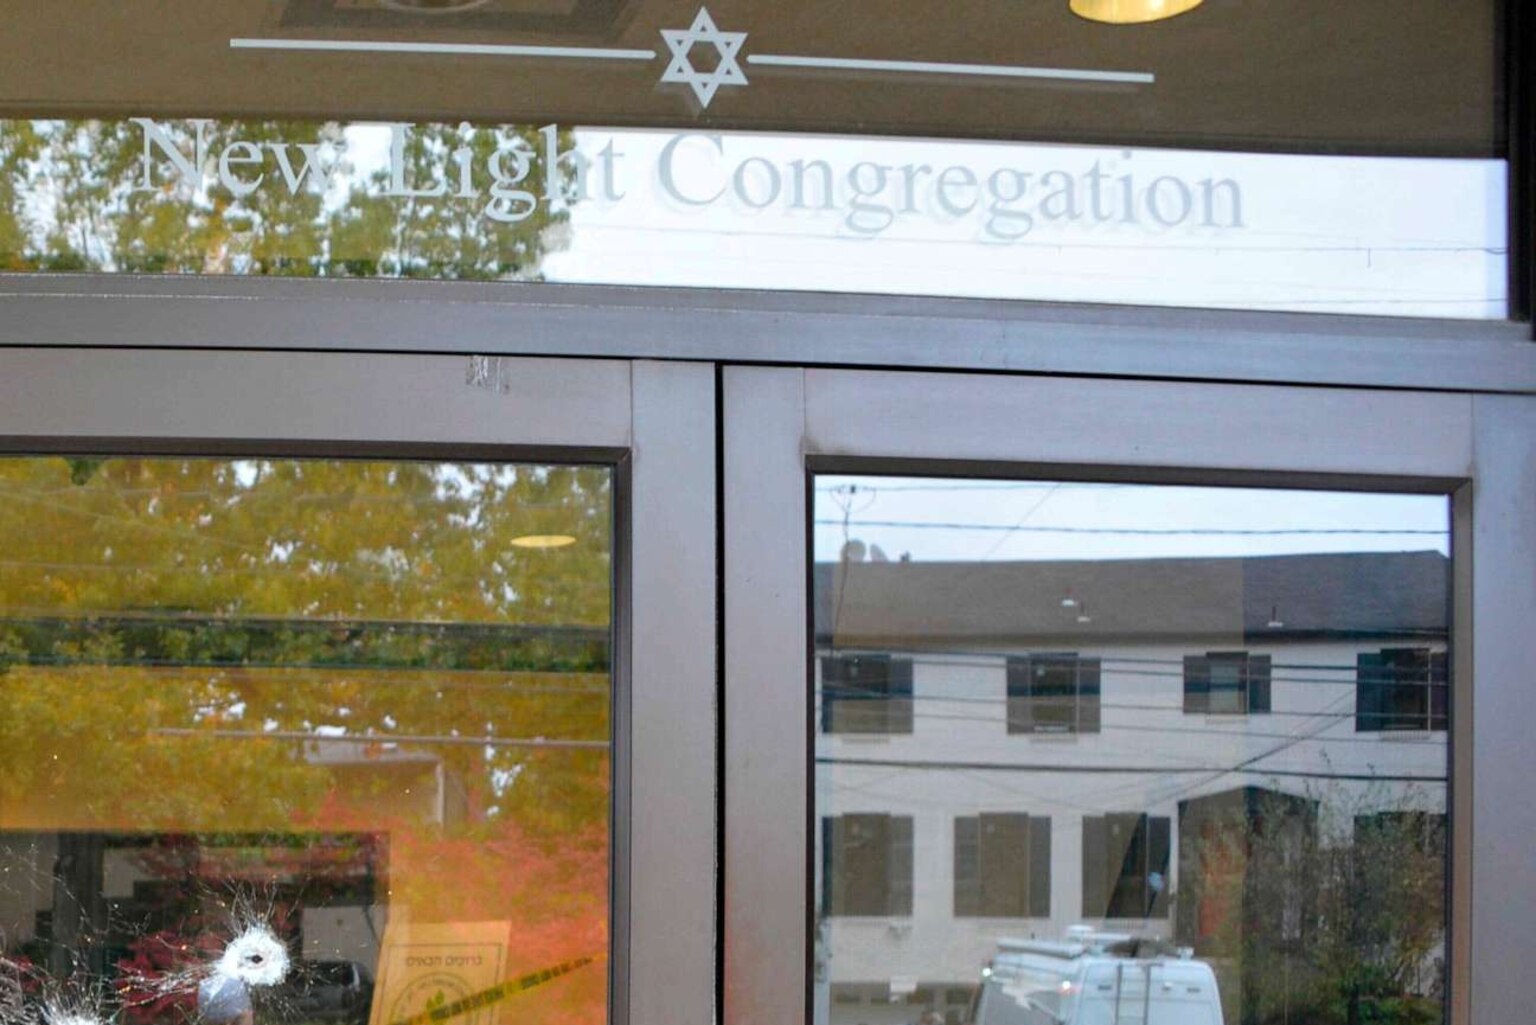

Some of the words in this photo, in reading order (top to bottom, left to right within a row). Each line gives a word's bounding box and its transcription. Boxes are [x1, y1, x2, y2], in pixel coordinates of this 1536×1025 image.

[130, 117, 345, 195] New
[383, 122, 624, 222] Light
[657, 132, 1246, 240] Congregation
